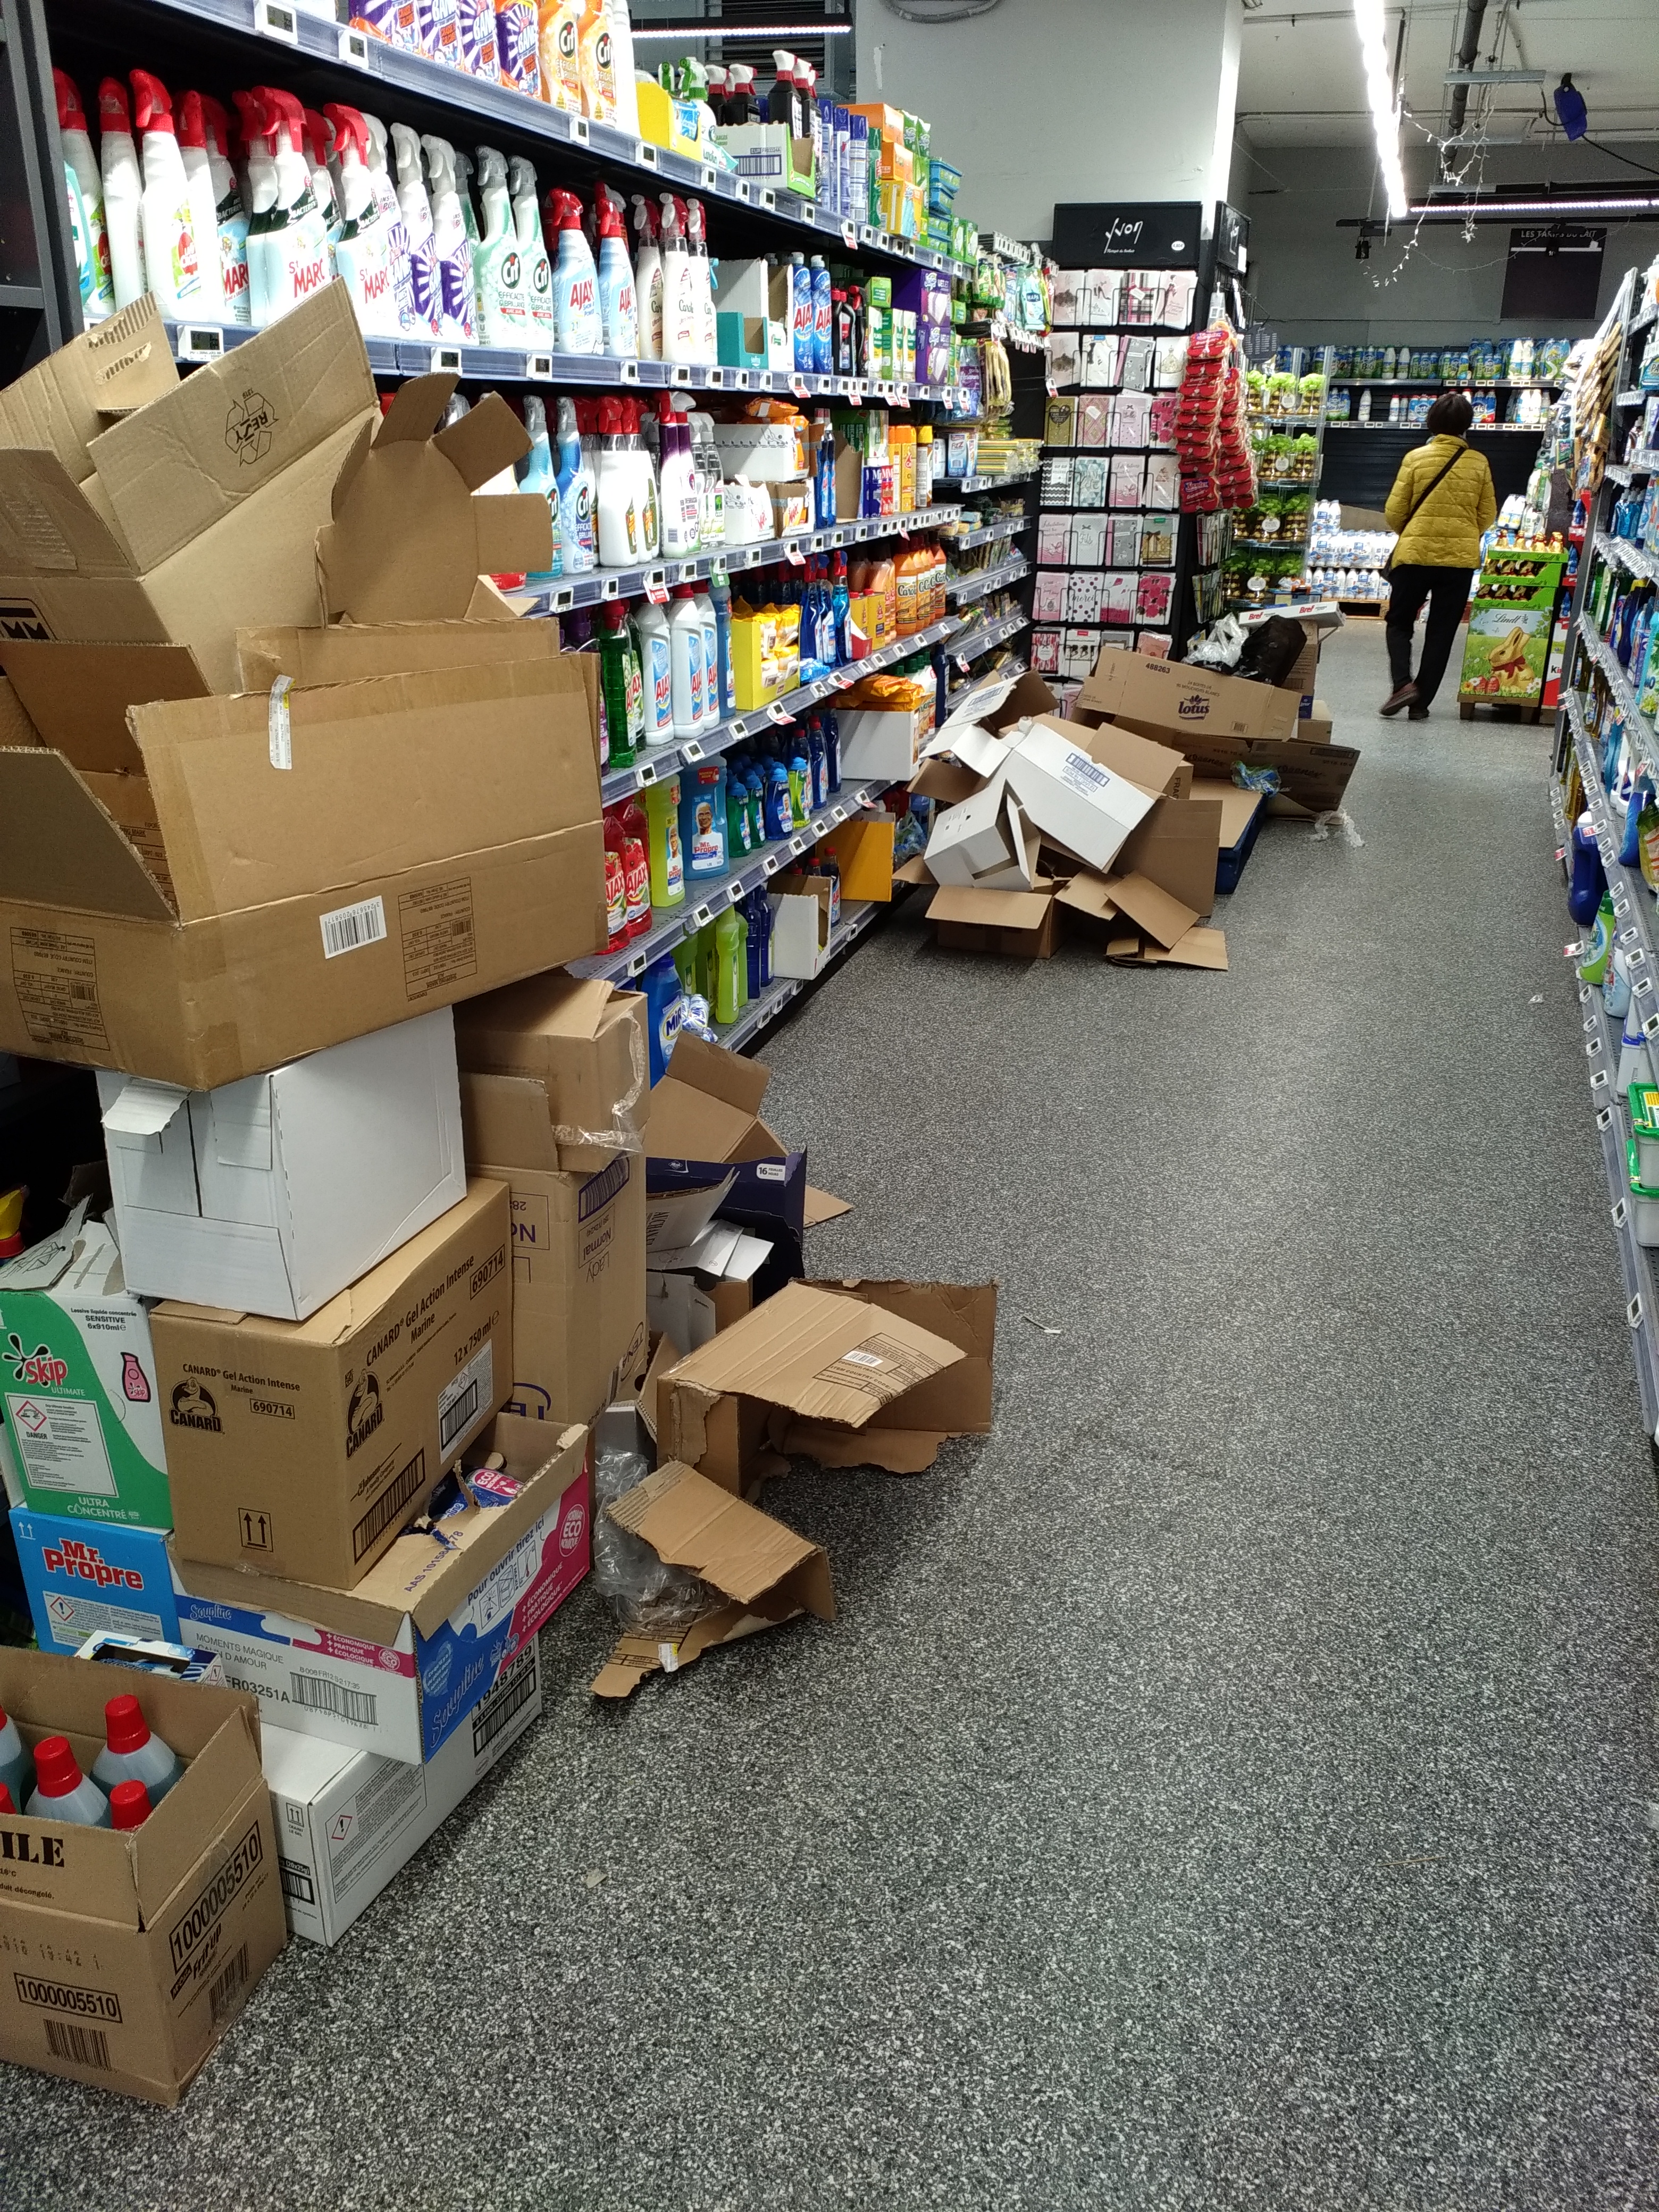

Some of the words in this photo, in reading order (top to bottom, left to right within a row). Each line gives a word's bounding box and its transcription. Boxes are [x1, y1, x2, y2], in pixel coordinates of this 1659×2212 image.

[559, 25, 575, 57] Cif
[597, 36, 611, 67] Cif
[294, 258, 325, 298] MARC
[502, 255, 520, 284] Cif
[533, 261, 549, 288] Cif
[570, 278, 594, 311] AJAX
[577, 488, 589, 516] Cif
[1071, 593, 1096, 602] merci
[1248, 612, 1263, 621] Bref
[1299, 605, 1314, 614] Bref
[1493, 613, 1522, 624] Lindt
[1145, 663, 1170, 674] 488263
[1182, 684, 1204, 694] MOUCHOIRS
[1178, 701, 1210, 715] lotus
[693, 844, 718, 853] Propre
[626, 861, 648, 898] AJAX
[327, 909, 350, 925] 205817
[758, 1167, 767, 1176] 16
[583, 1227, 612, 1261] Normal
[472, 1250, 504, 1293] 690714
[585, 1250, 610, 1283] Lady
[405, 1305, 419, 1327] Gel
[420, 1283, 446, 1313] Action
[446, 1255, 475, 1291] Intense
[85, 1316, 126, 1324] SENSITIVE
[410, 1312, 436, 1345] Marine
[454, 1347, 463, 1365] 12
[468, 1328, 482, 1351] 750
[622, 1332, 644, 1369] TENA
[25, 1356, 68, 1386] Skip
[849, 1368, 874, 1380] COUNTRY
[862, 1366, 883, 1377] FRANCE
[222, 1370, 237, 1381] Gel
[238, 1372, 266, 1387] Action
[267, 1377, 301, 1392] Intense
[231, 1384, 254, 1395] Marine
[51, 1386, 86, 1396] ULTIMATE
[253, 1401, 292, 1418] 690714
[170, 1411, 222, 1434] CANARD
[346, 1401, 383, 1460] CANARD
[26, 1431, 48, 1440] DANGER
[477, 1471, 496, 1485] ECO
[78, 1496, 110, 1508] ULTRA
[67, 1503, 127, 1520] CONCENTRÉ
[567, 1510, 584, 1521] FORMAT
[563, 1521, 582, 1538] ECO
[60, 1539, 104, 1564] Mr.
[489, 1548, 515, 1583] ouvrir
[515, 1529, 534, 1553] tirez
[535, 1515, 545, 1533] ici
[42, 1547, 145, 1590] Propre
[404, 1574, 426, 1592] AAS
[527, 1582, 554, 1618] PRATIQUE
[189, 1604, 232, 1621] Soupline
[196, 1632, 241, 1653] MOMENTS
[243, 1646, 284, 1664] MAGIQUE
[332, 1634, 376, 1652] ÉCONOMIQUE
[333, 1641, 365, 1655] PRATIQUE
[232, 1654, 267, 1670] AMOUR
[383, 1652, 398, 1665] ECO
[430, 1653, 484, 1749] Soupline
[173, 1833, 259, 1961] 1000005510
[19, 1978, 118, 2018] 1000005510
